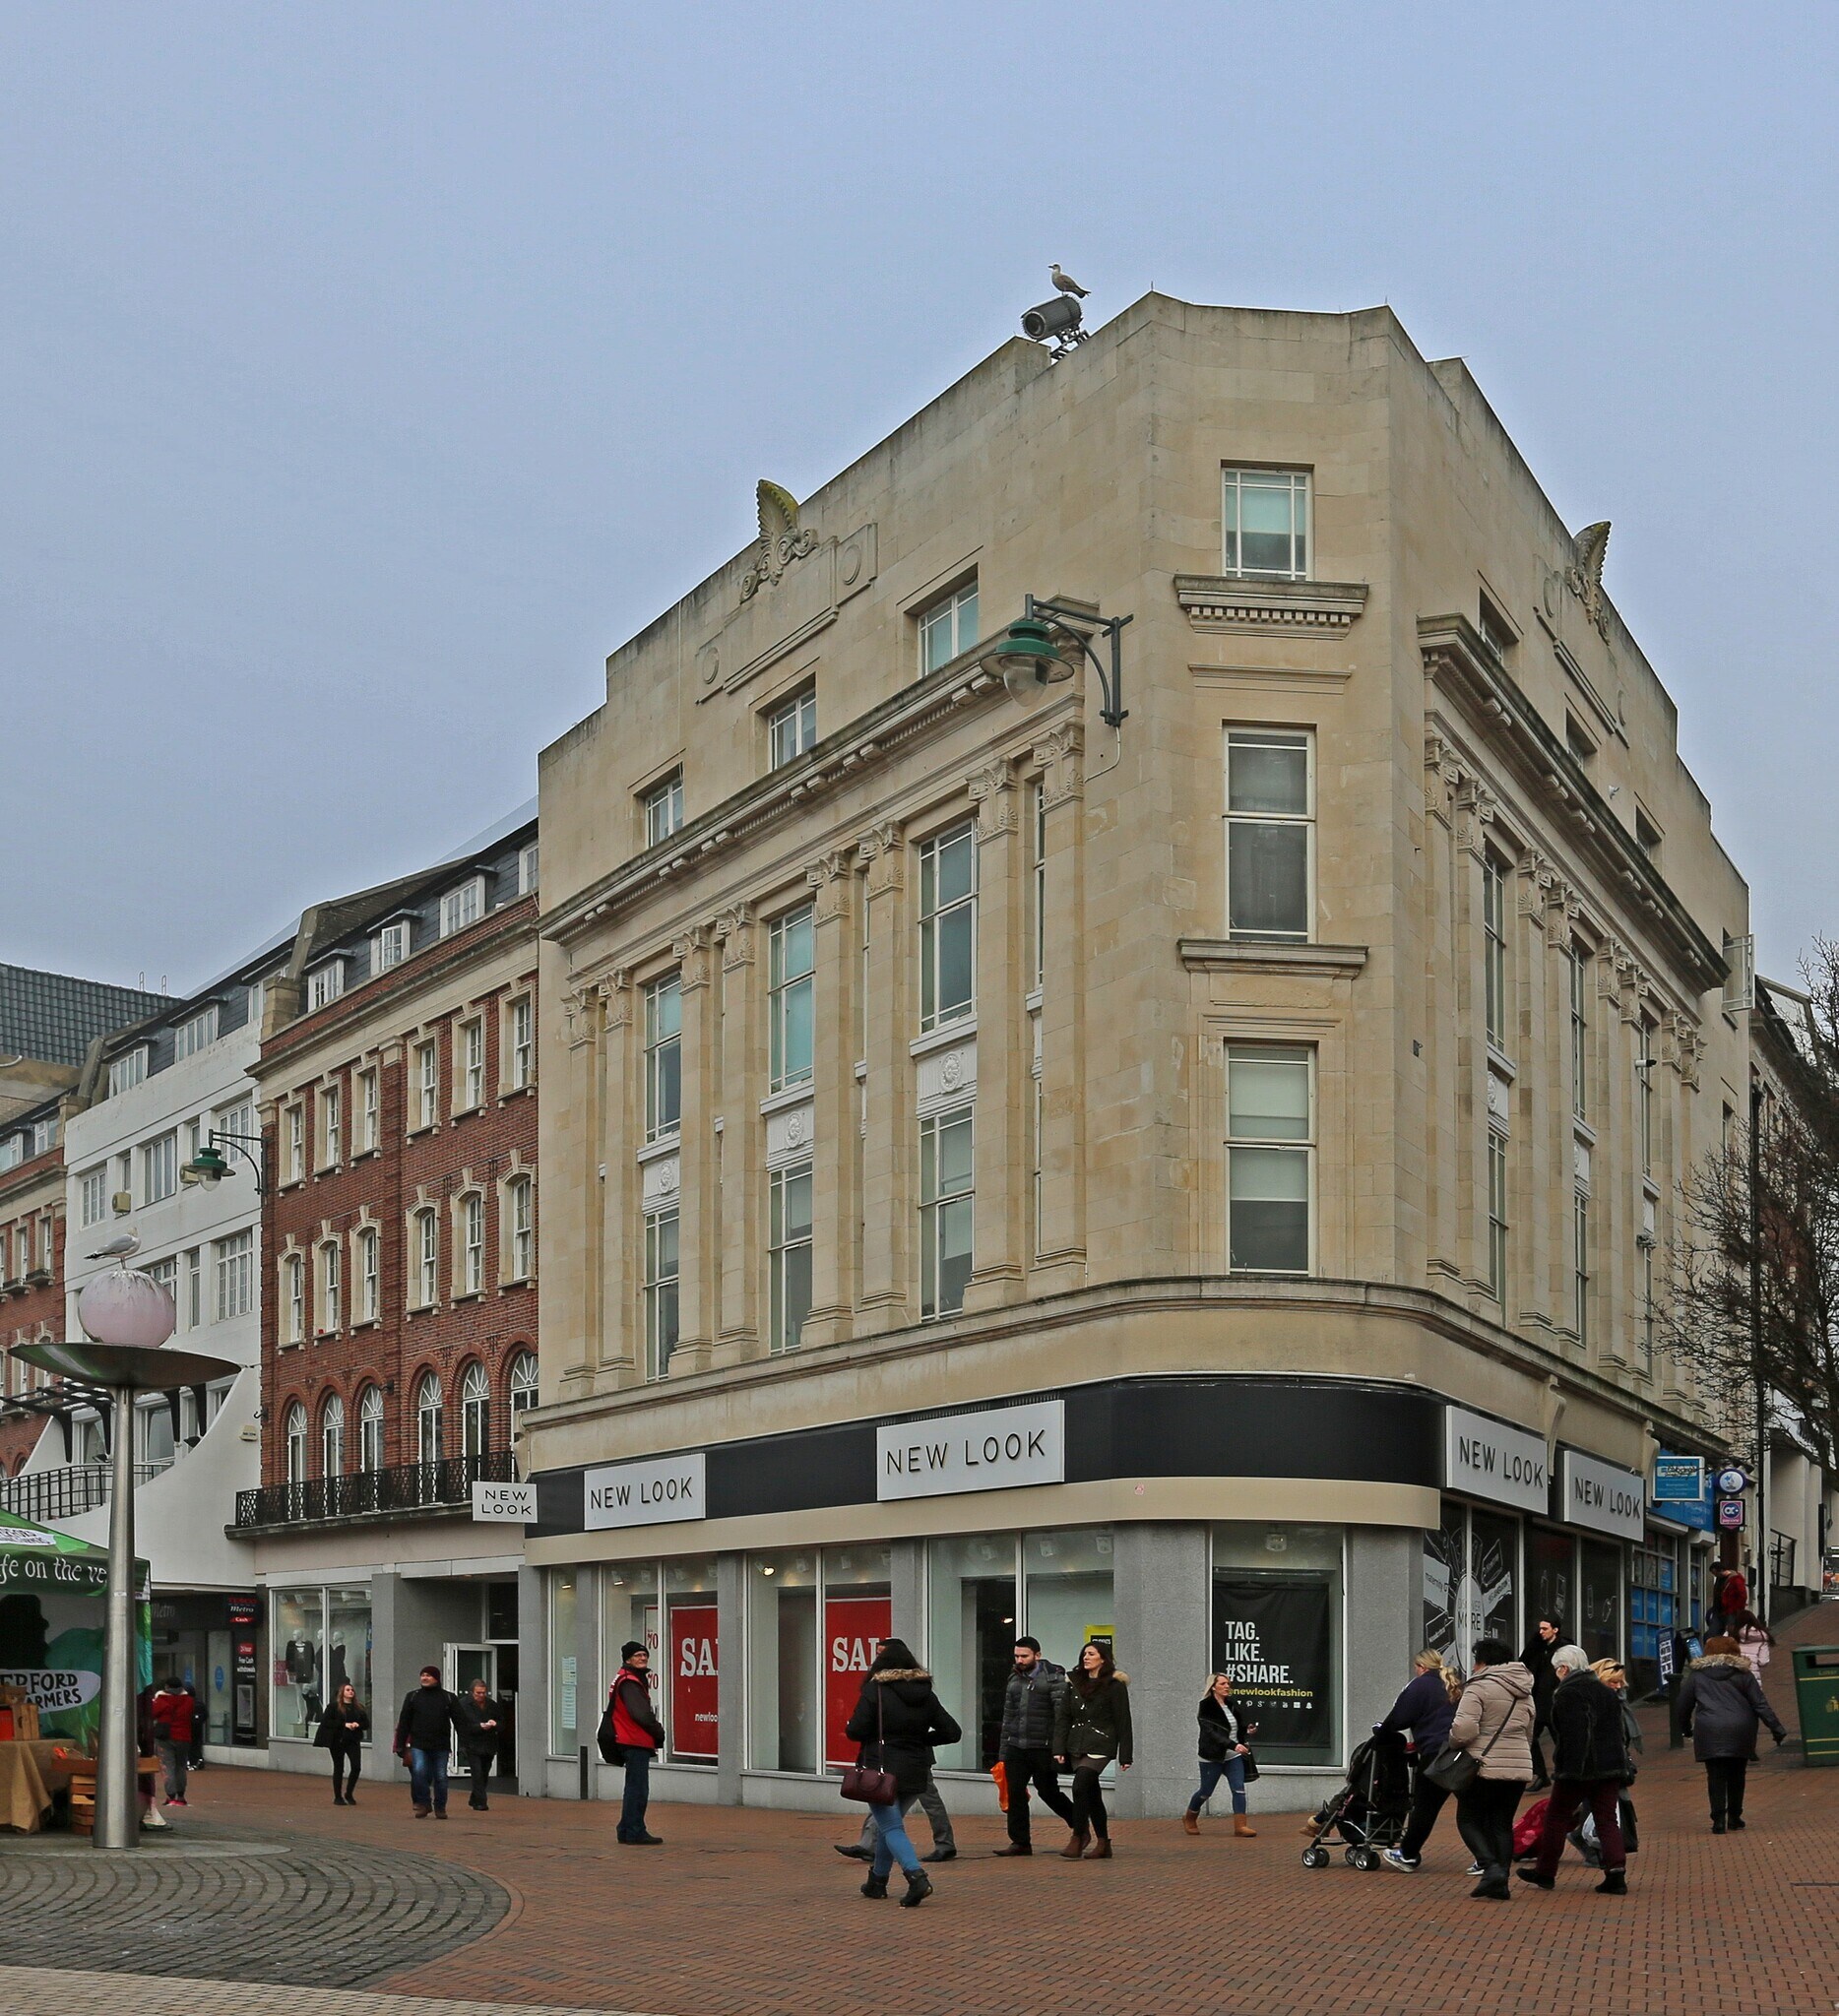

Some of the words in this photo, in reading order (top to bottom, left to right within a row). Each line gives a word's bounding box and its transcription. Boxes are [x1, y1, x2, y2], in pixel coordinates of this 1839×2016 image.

[887, 1442, 947, 1475] NEW
[965, 1429, 1046, 1466] LOOK
[1459, 1436, 1495, 1474] NEW
[1503, 1452, 1544, 1488] LOOK
[484, 1489, 528, 1500] NEW
[590, 1484, 631, 1509] NEW
[640, 1477, 693, 1503] LOOK
[1575, 1477, 1605, 1508] NEW
[1610, 1488, 1641, 1520] LOOK
[481, 1504, 533, 1516] LOOK
[25, 1560, 48, 1579] on
[53, 1556, 83, 1581] the
[88, 1565, 108, 1584] ve
[1225, 1621, 1260, 1641] TAG.
[680, 1637, 719, 1676] SA
[1225, 1642, 1265, 1662] LIKE.
[1225, 1664, 1295, 1683] #SHARE.
